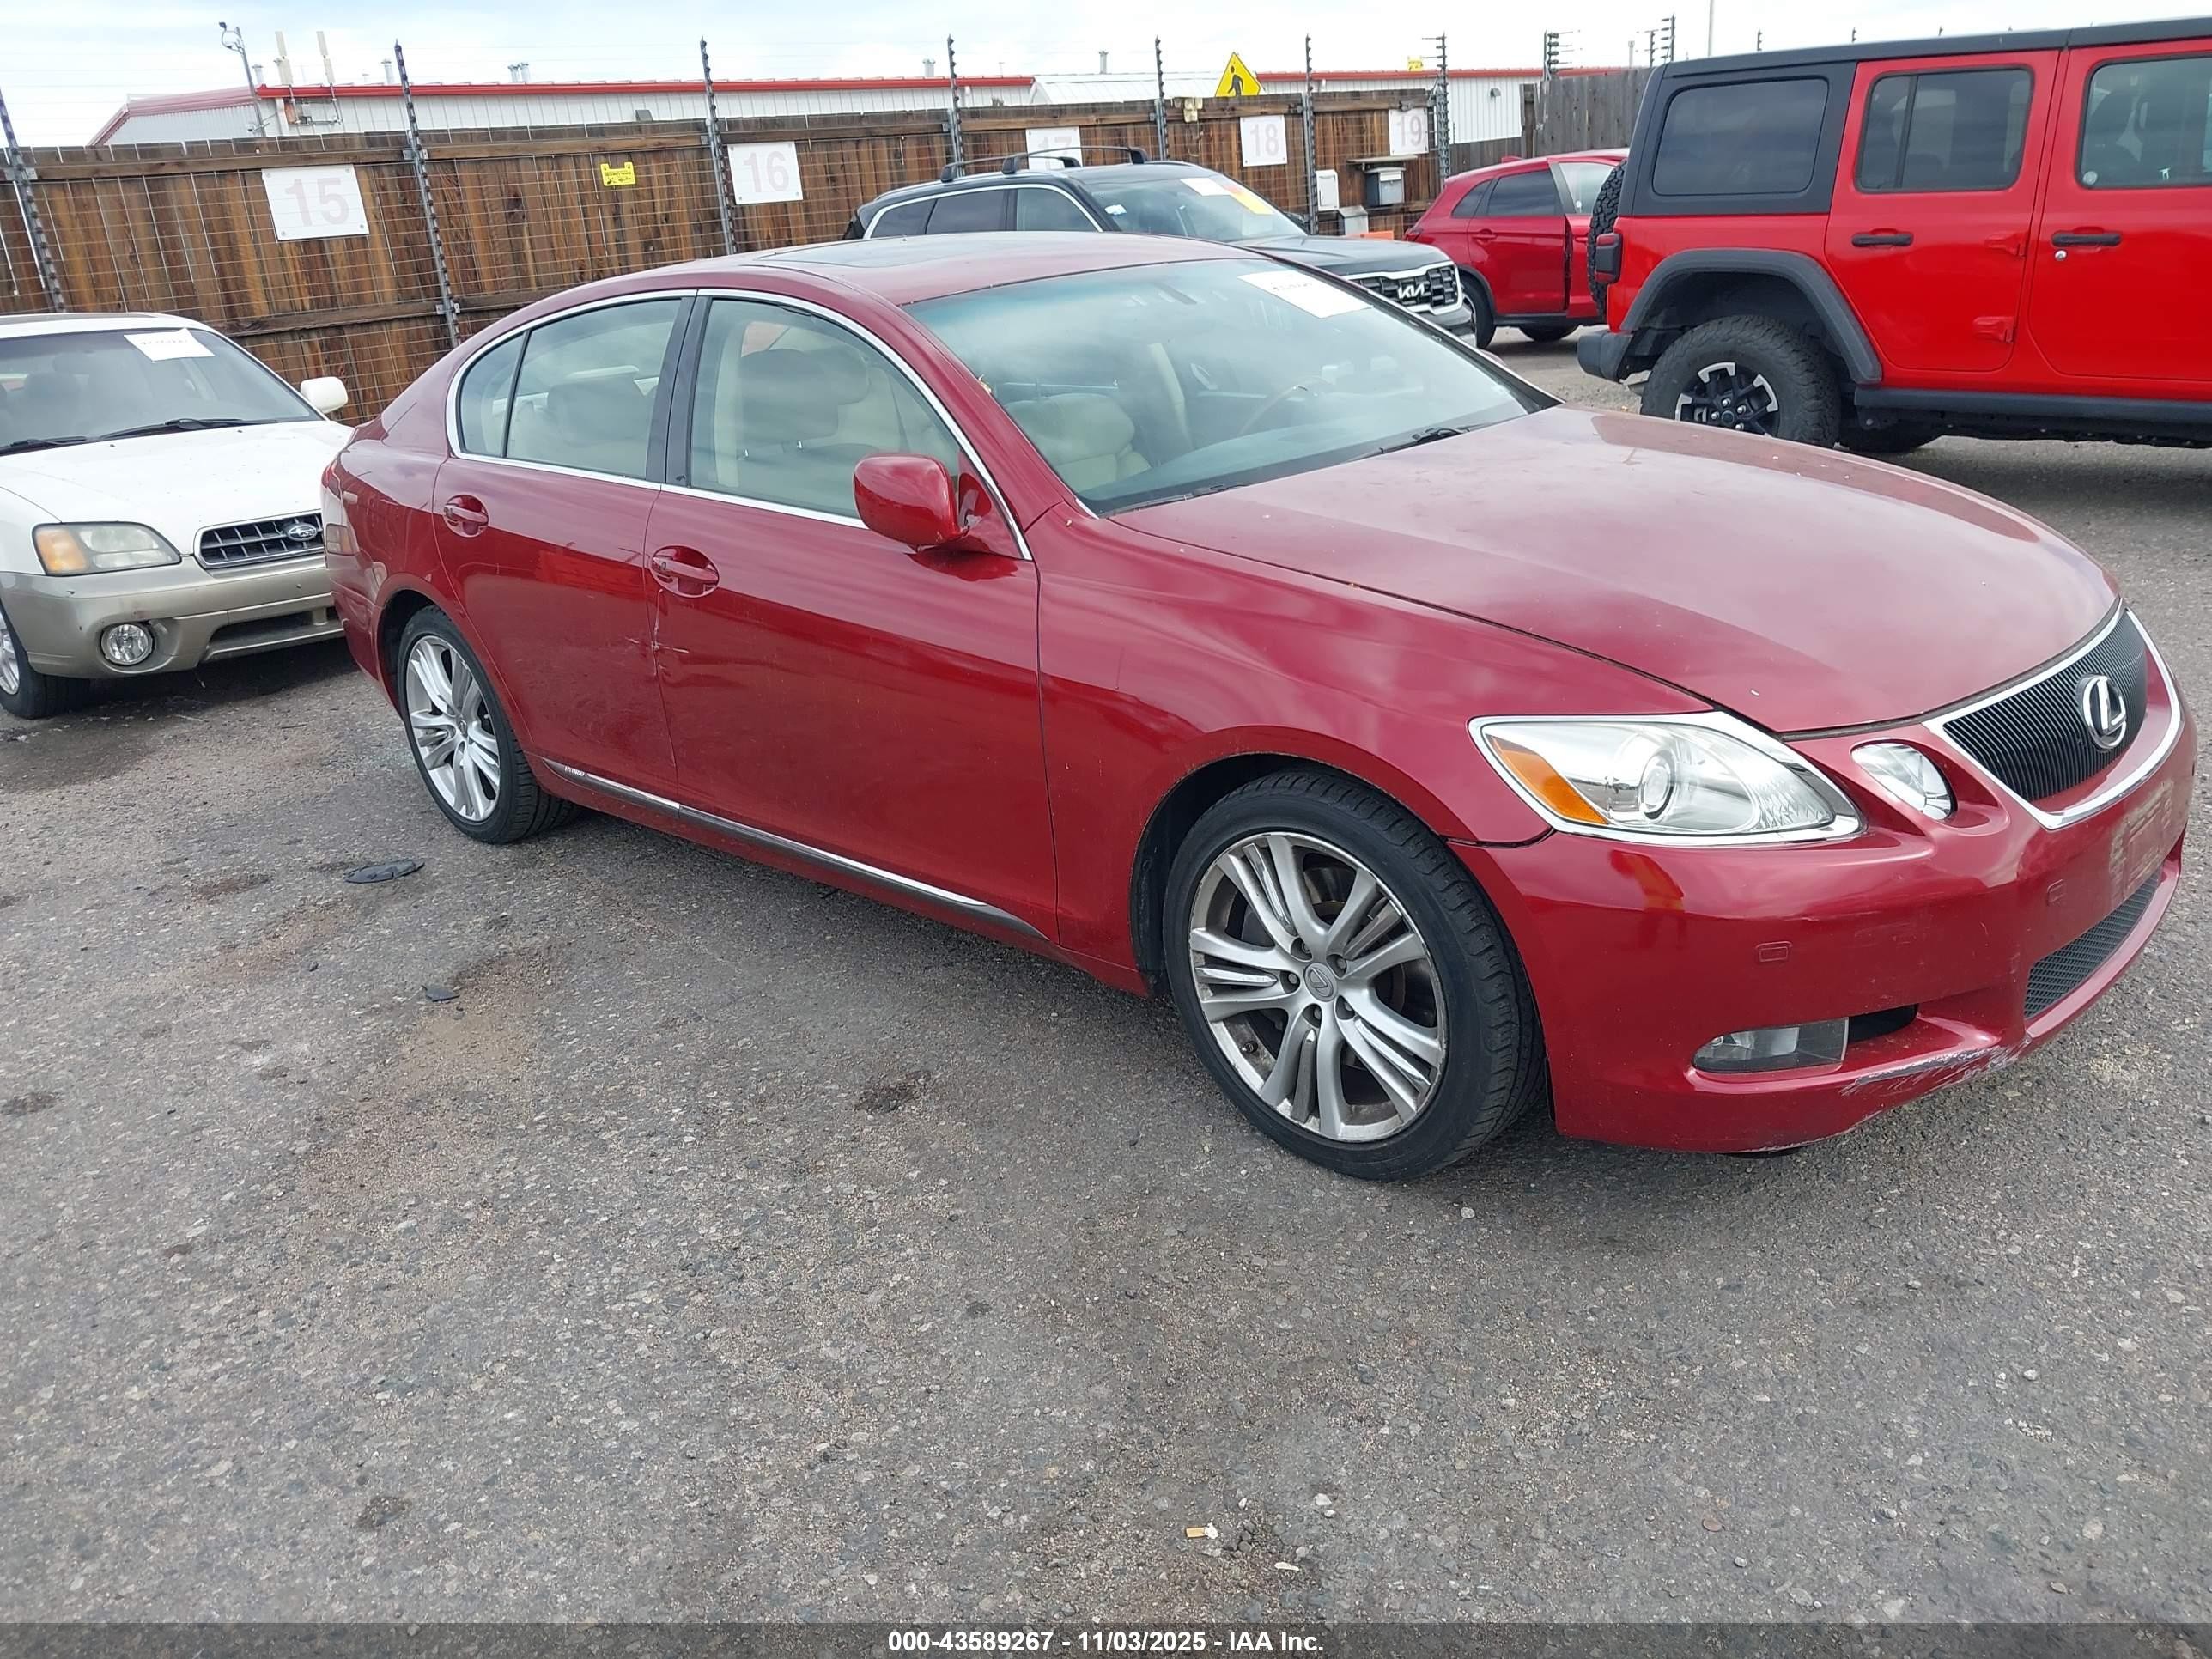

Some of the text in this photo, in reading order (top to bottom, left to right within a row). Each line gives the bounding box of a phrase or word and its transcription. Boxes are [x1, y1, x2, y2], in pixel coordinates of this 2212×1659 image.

[1249, 123, 1279, 157] 18
[1396, 115, 1422, 146] 19
[743, 151, 790, 193] 16
[284, 178, 350, 227] 15
